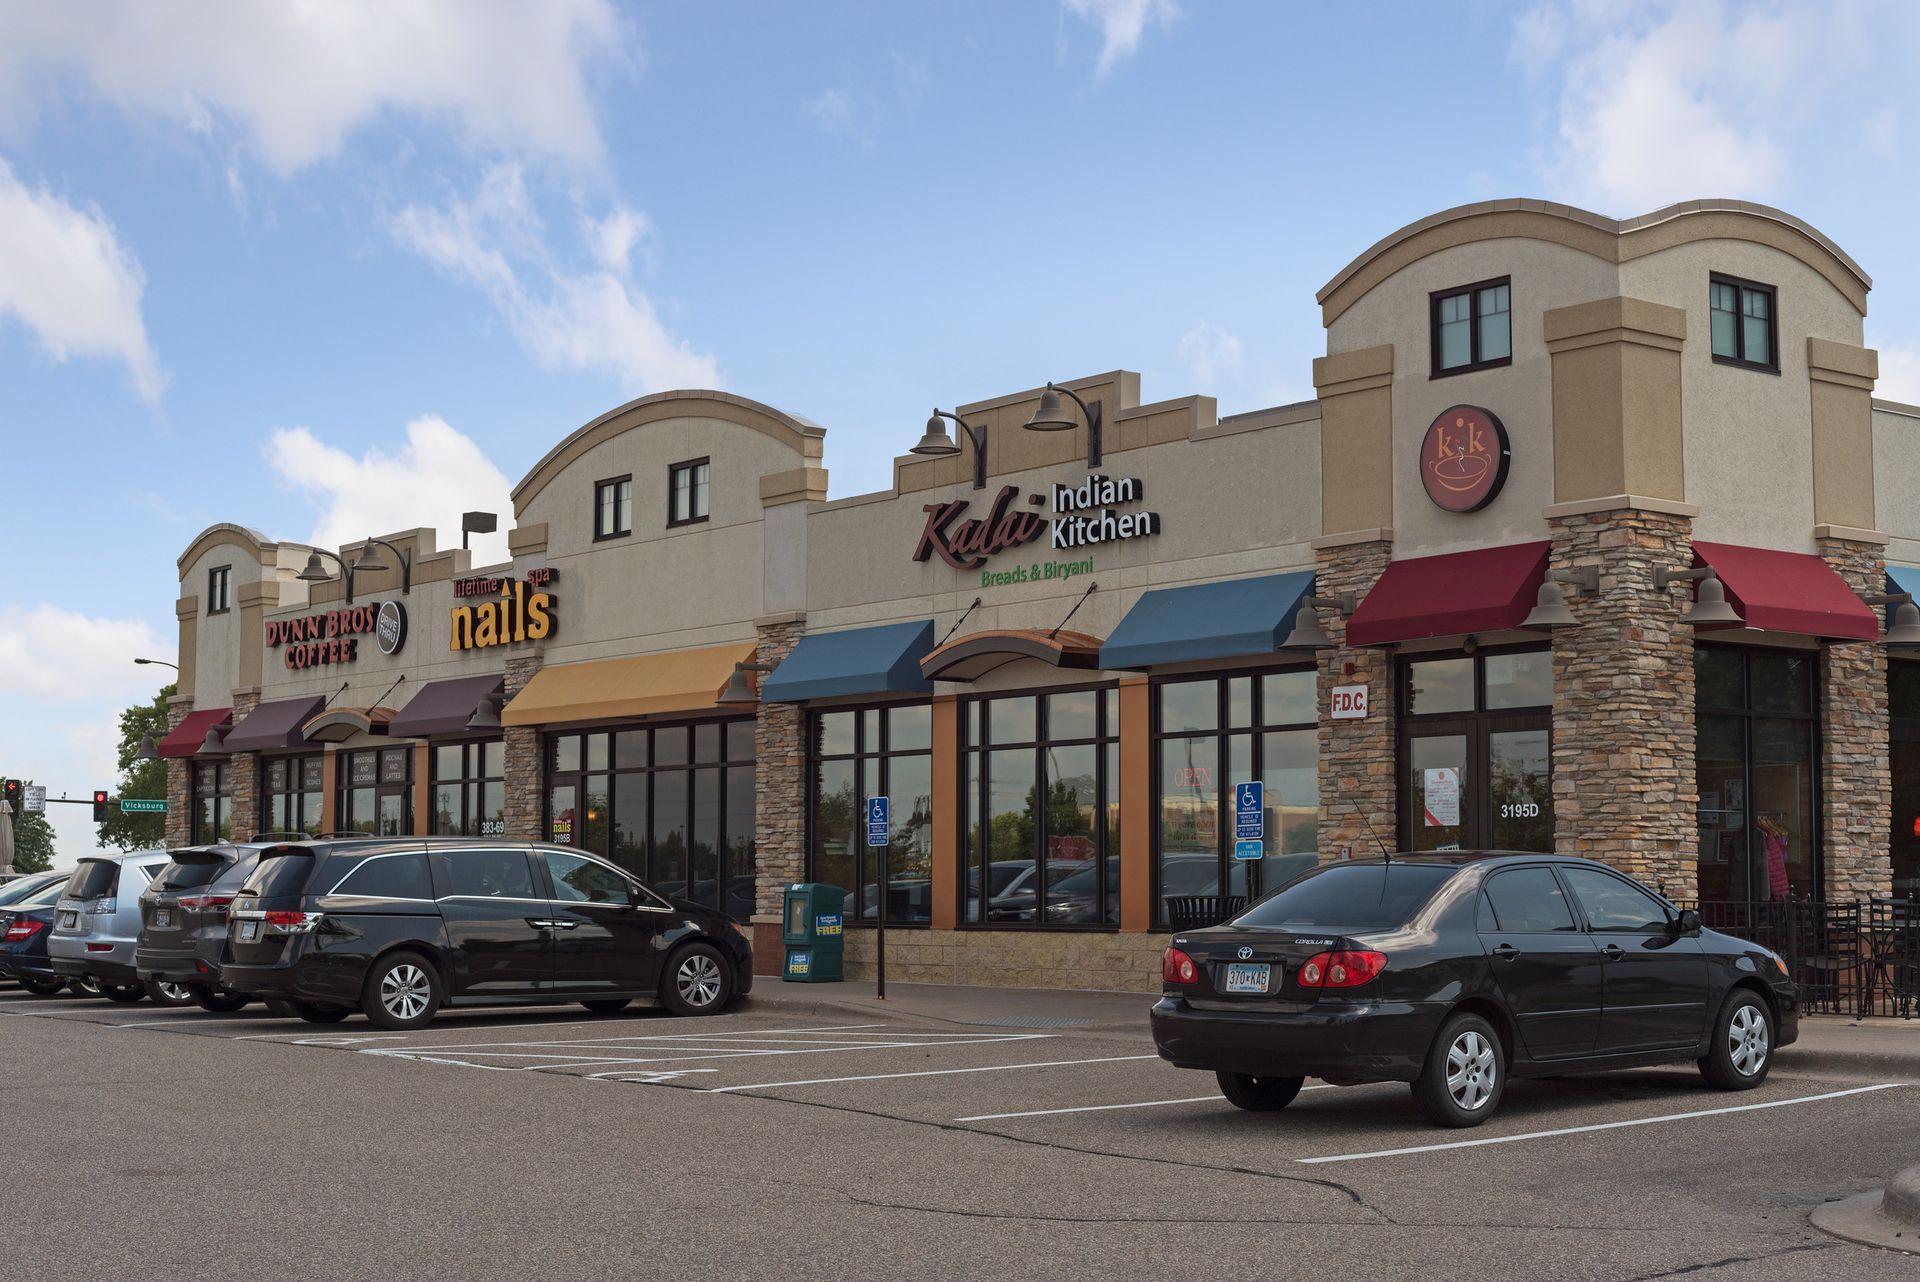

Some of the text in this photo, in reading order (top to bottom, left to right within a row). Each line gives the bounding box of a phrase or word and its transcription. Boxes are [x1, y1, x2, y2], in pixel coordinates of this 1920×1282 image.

[1052, 475, 1134, 513] Indian
[912, 485, 1044, 570] Kadai
[1051, 509, 1151, 549] Kitchen
[981, 556, 1094, 587] Breads & Biryani
[453, 567, 551, 598] lifetime spa
[380, 612, 398, 632] DRIVE
[450, 578, 551, 651] nails
[265, 602, 374, 648] DUNN BROS
[379, 624, 396, 643] THRU
[285, 638, 352, 669] COFFEE
[1332, 692, 1366, 711] F.D.C.
[1174, 767, 1212, 787] OPEN
[125, 802, 164, 810] Vicksburg
[1501, 803, 1539, 818] 3195D
[481, 822, 505, 834] 383-69
[553, 820, 571, 833] nails
[553, 834, 570, 843] 3195B
[816, 925, 842, 936] FREE
[789, 964, 809, 974] FREE
[1229, 970, 1267, 985] 370 KAB
